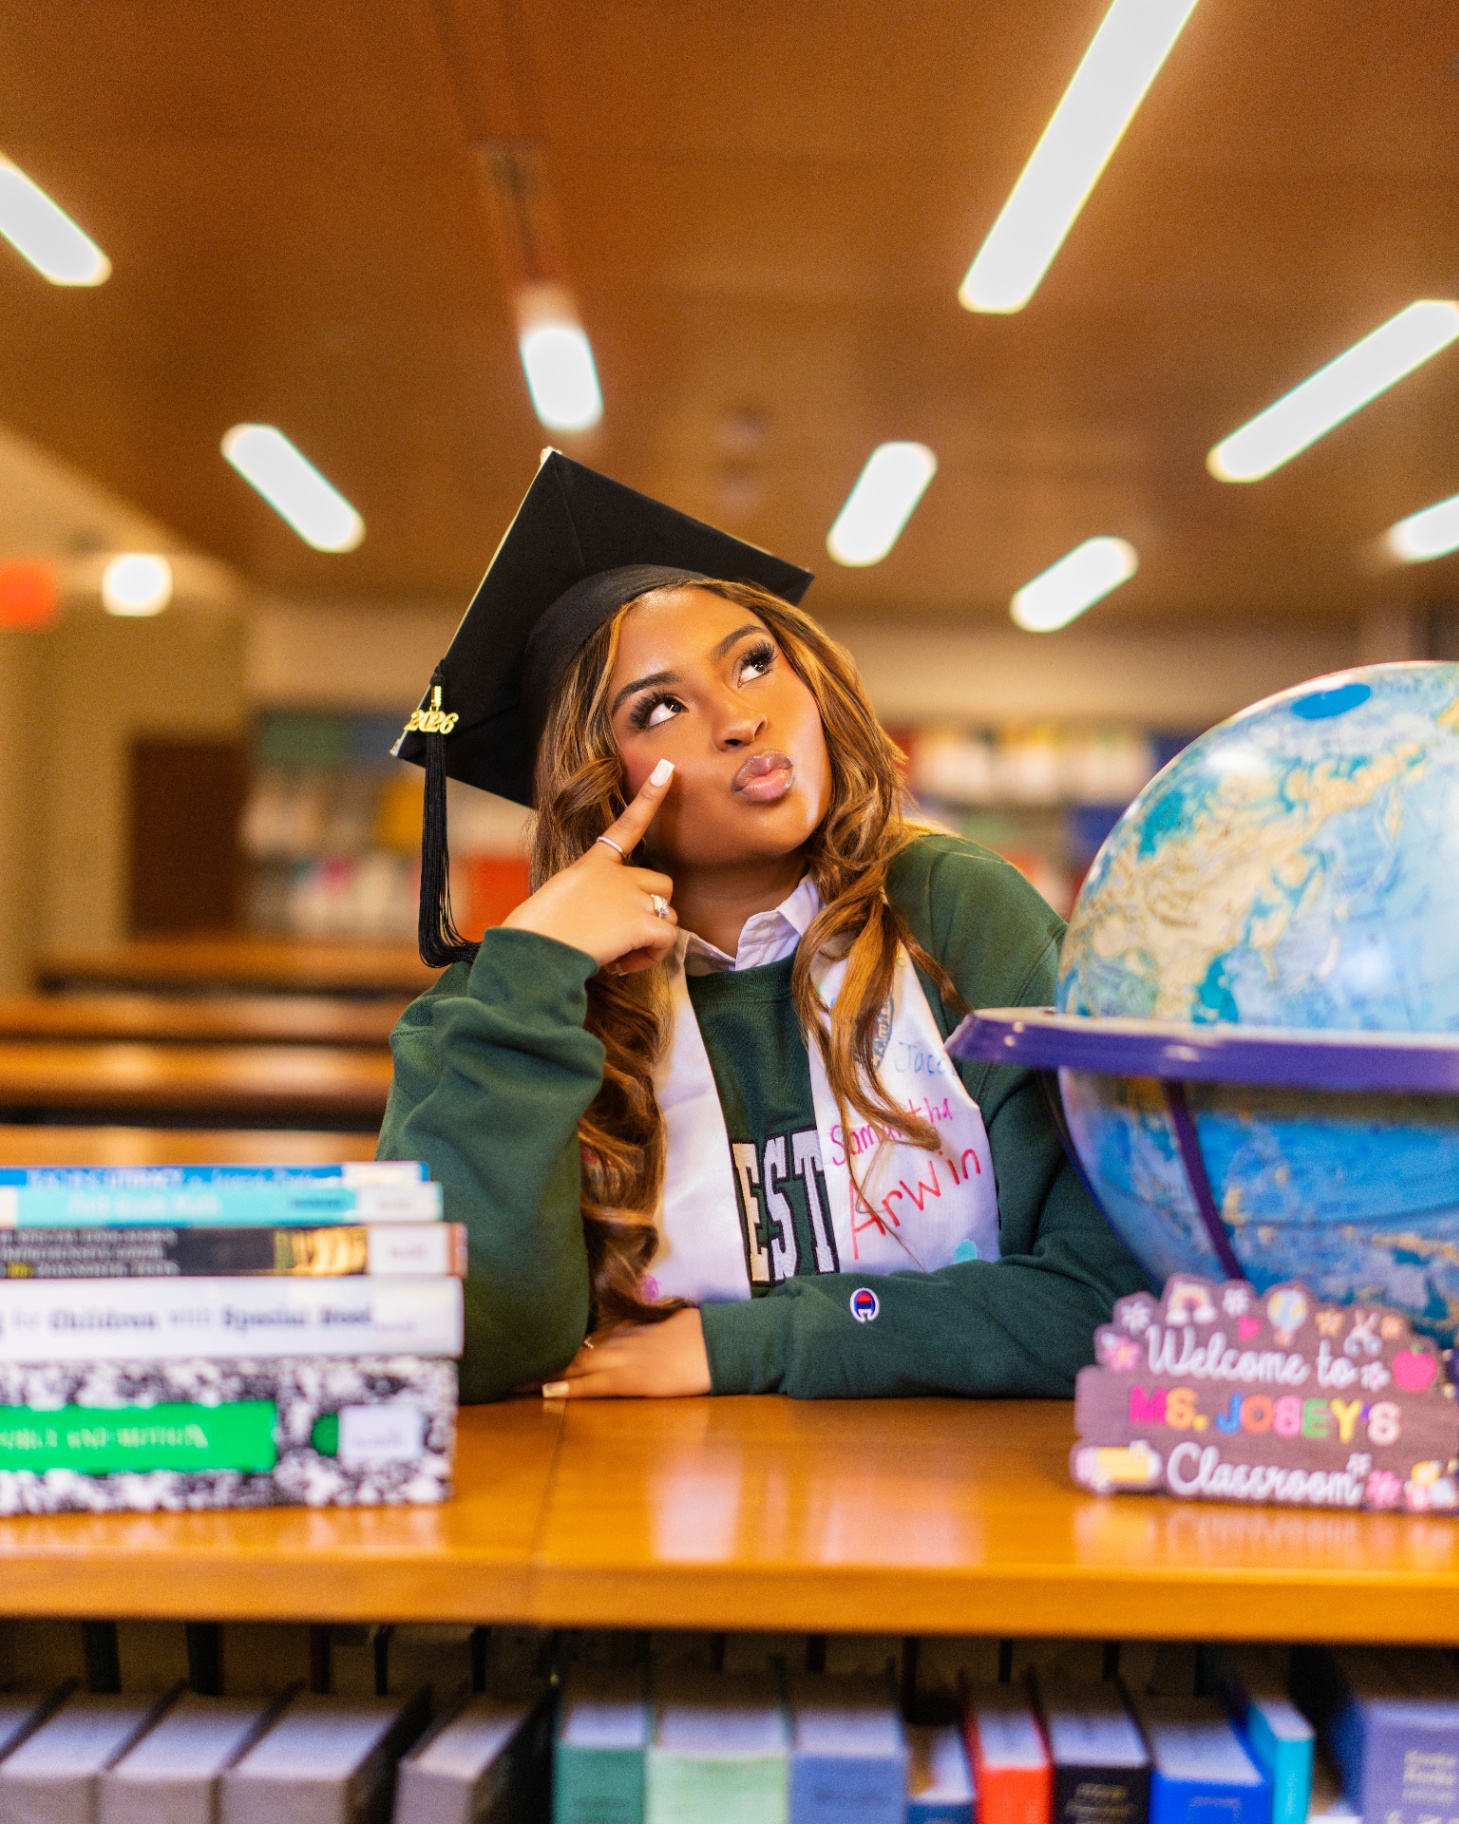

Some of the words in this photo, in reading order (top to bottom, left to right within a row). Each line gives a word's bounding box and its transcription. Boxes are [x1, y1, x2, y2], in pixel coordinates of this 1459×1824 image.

[404, 709, 459, 734] 2026
[1145, 1324, 1310, 1386] Welcome
[1317, 1338, 1364, 1389] to
[1166, 1440, 1365, 1507] Classroom
